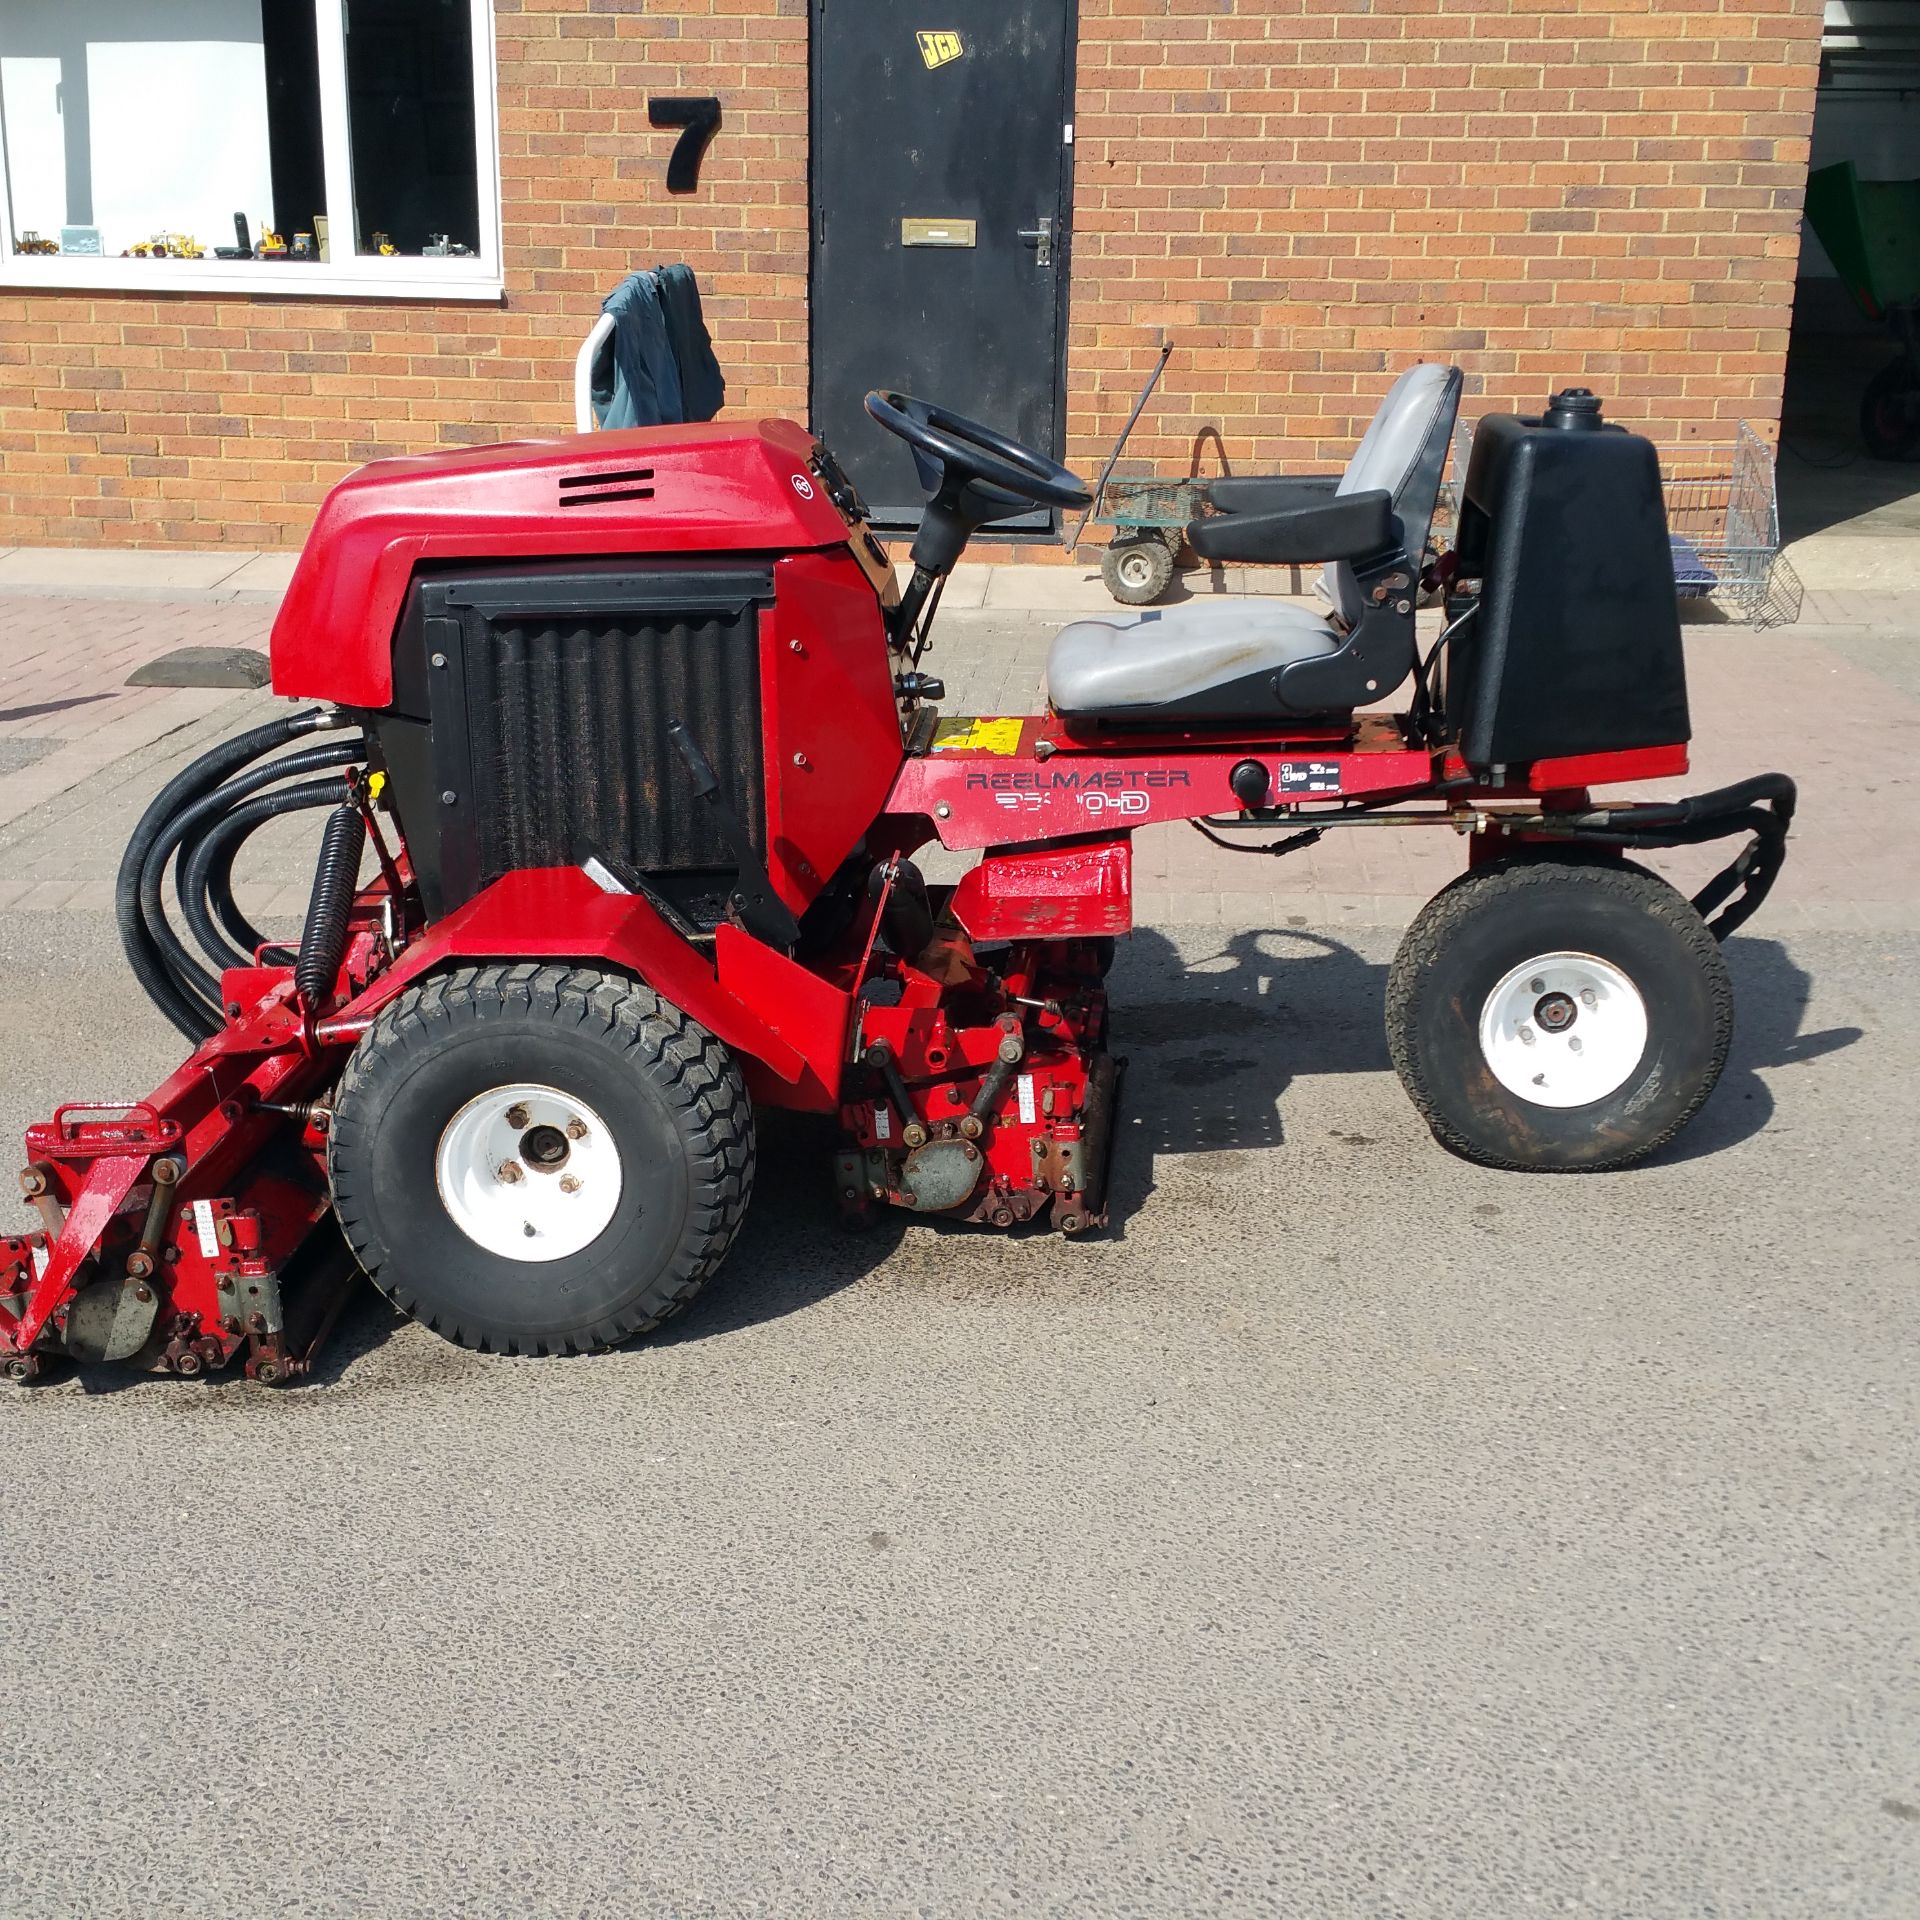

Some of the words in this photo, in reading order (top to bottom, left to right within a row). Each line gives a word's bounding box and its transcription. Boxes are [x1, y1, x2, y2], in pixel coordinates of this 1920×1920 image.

[922, 34, 960, 66] JCB
[648, 97, 721, 194] 7
[966, 770, 1192, 790] REELMASTER
